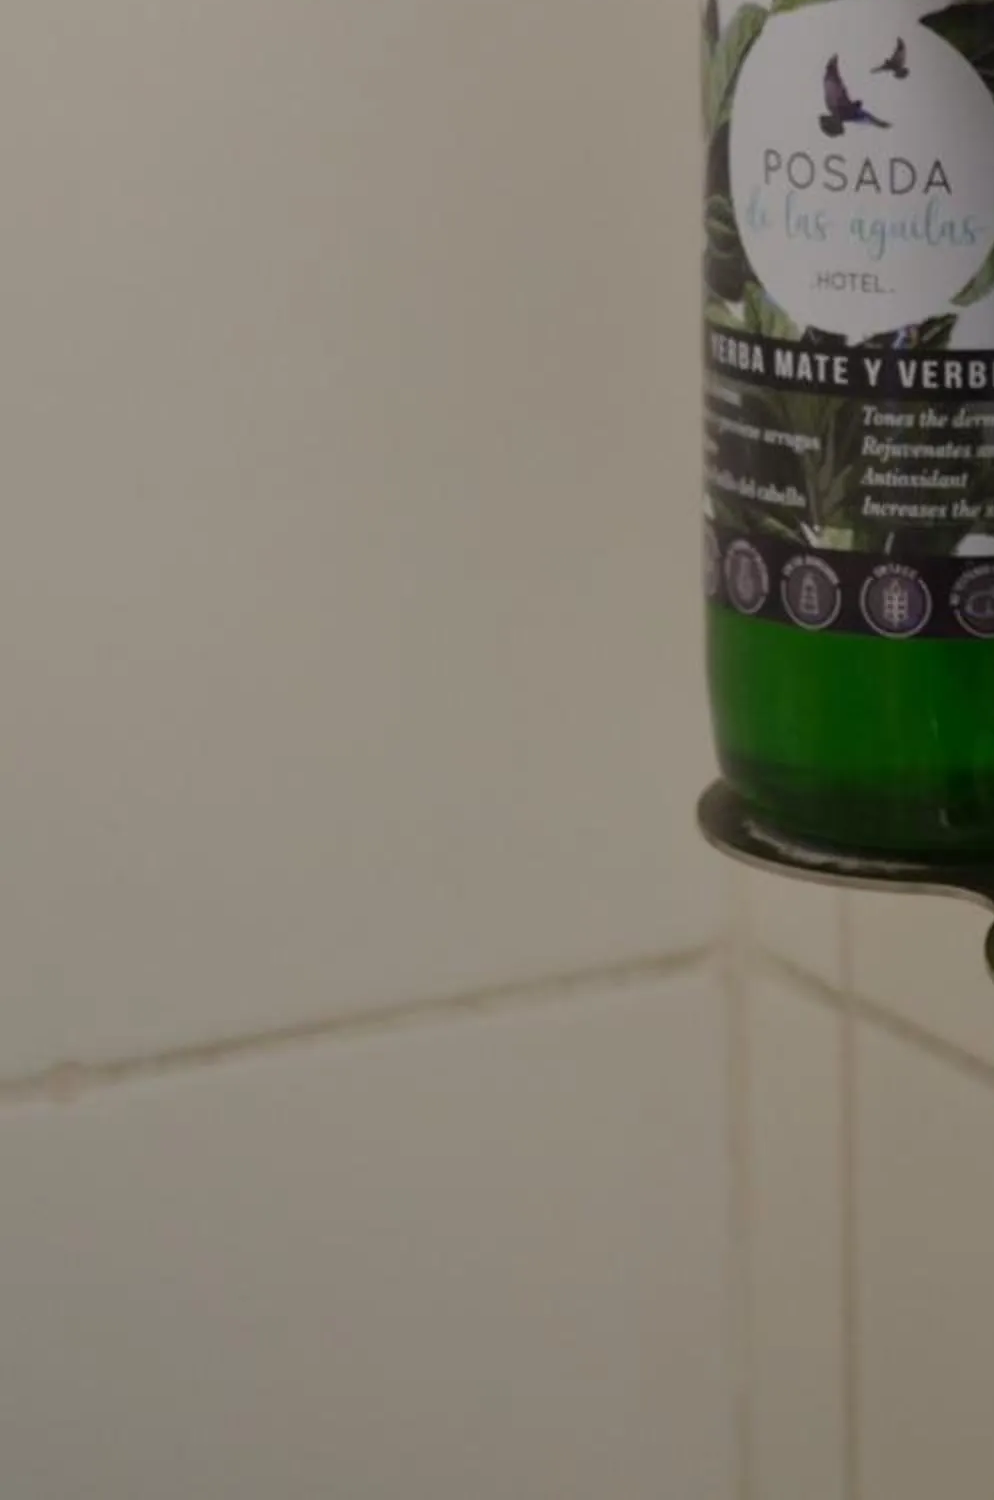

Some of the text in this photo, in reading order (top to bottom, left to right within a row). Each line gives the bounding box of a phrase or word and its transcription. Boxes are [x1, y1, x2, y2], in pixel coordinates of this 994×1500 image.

[763, 148, 952, 195] POSADA
[774, 349, 849, 385] MATE
[864, 358, 882, 388] Y
[919, 407, 948, 428] the
[859, 466, 970, 489] Antioxidant
[861, 495, 949, 518] Increases
